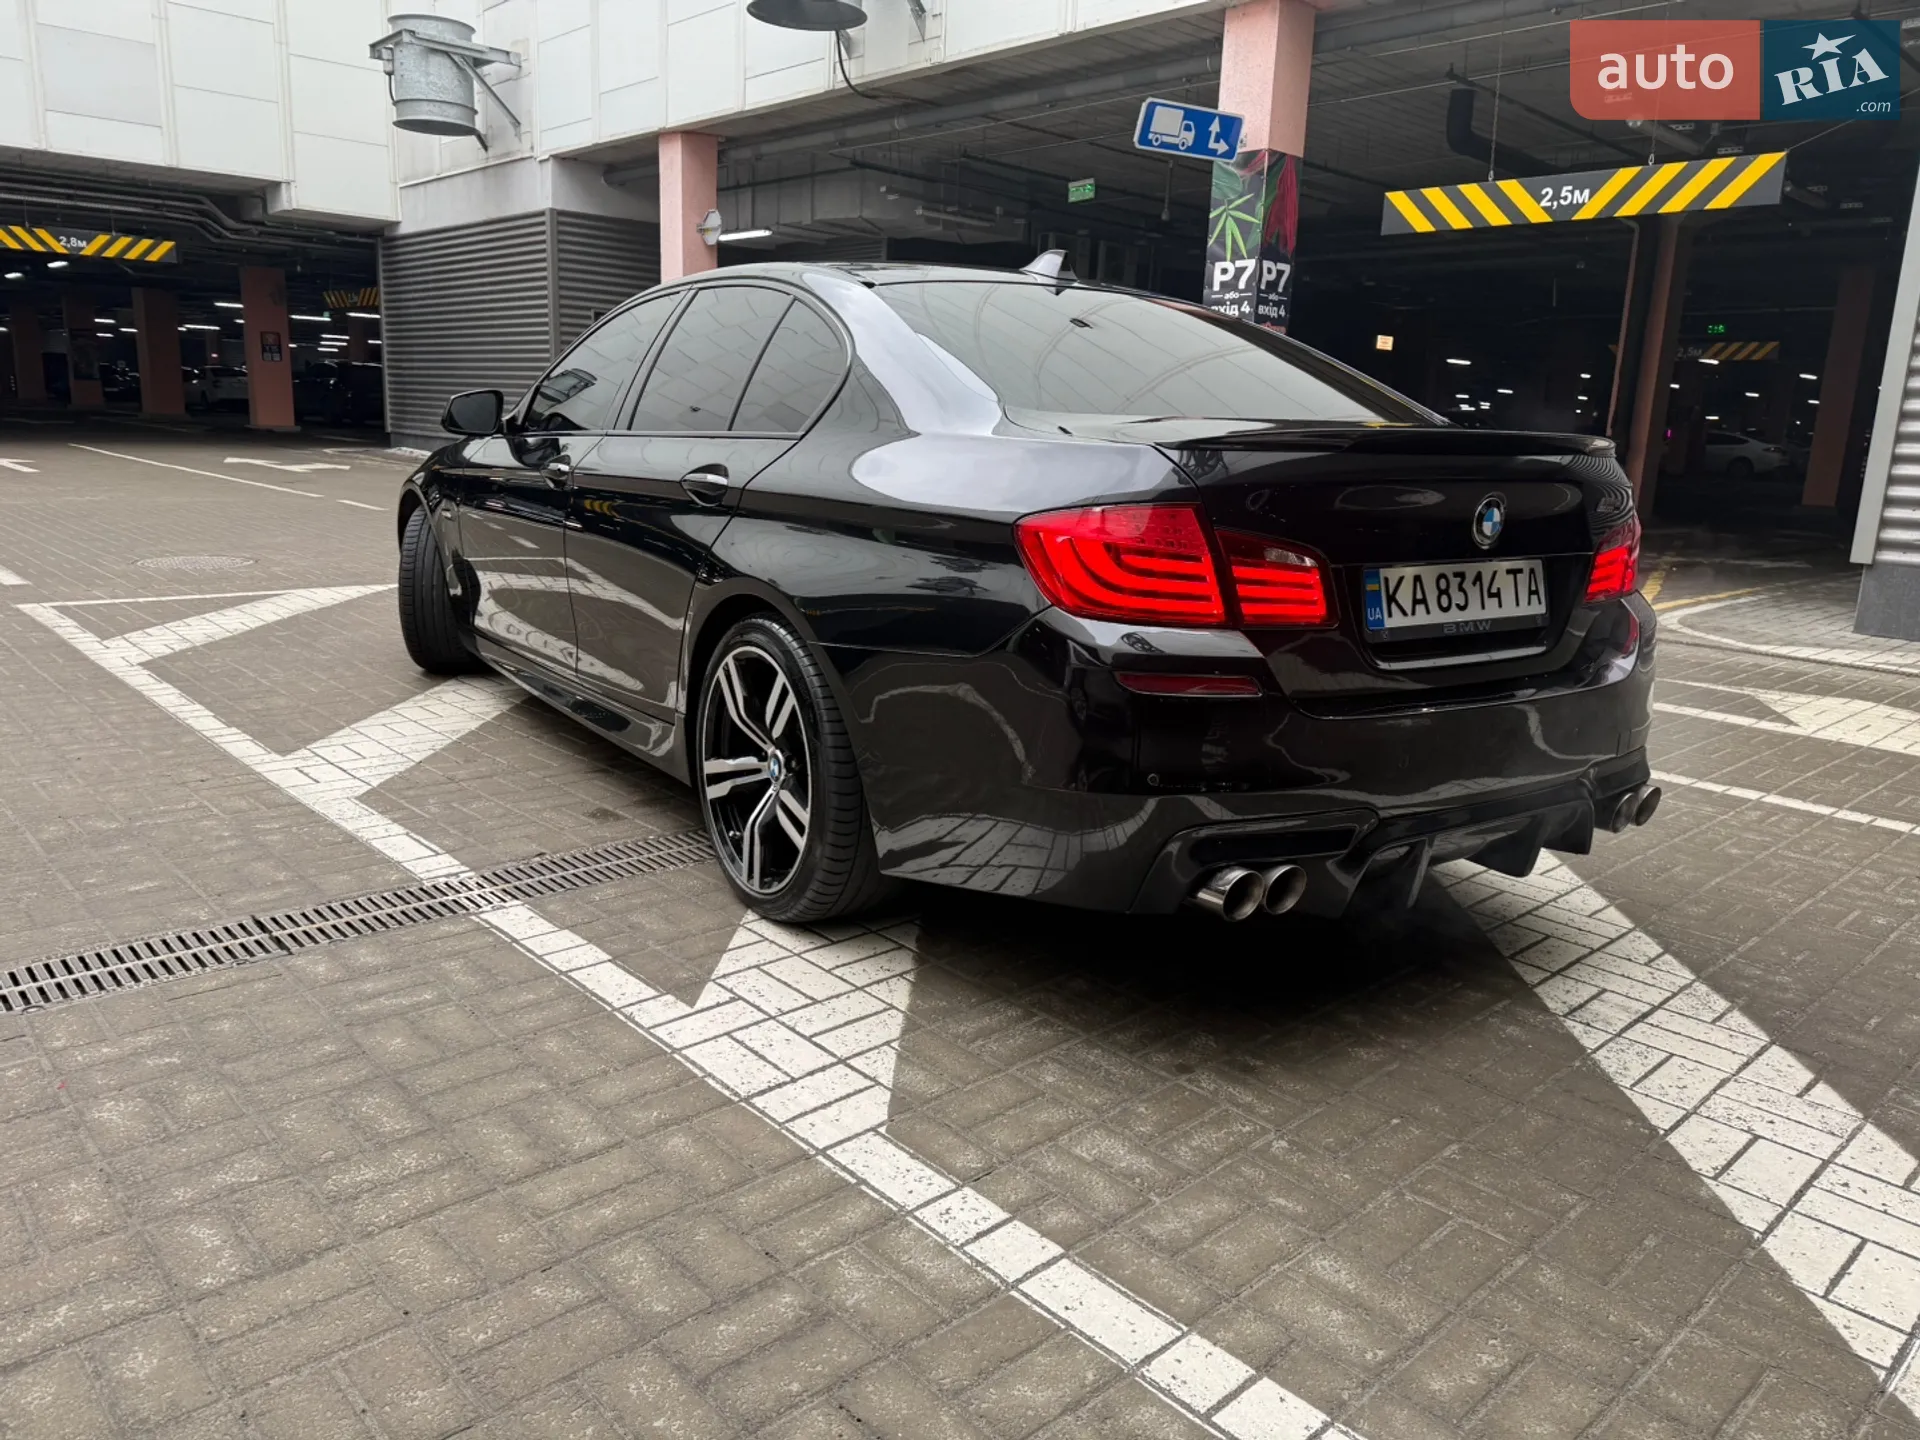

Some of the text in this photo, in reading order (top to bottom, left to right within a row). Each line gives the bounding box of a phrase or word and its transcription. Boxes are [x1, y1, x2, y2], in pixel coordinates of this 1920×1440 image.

[1540, 184, 1590, 209] 2,5м
[58, 236, 87, 248] 2,8м
[1212, 258, 1256, 292] P7
[1260, 259, 1291, 293] P7
[1223, 290, 1240, 300] або
[1210, 300, 1251, 317] хід 4
[1258, 302, 1286, 318] вхід 4
[1383, 567, 1543, 619] KA 8314 TA
[1367, 607, 1383, 621] UA
[1443, 620, 1493, 634] BMW
